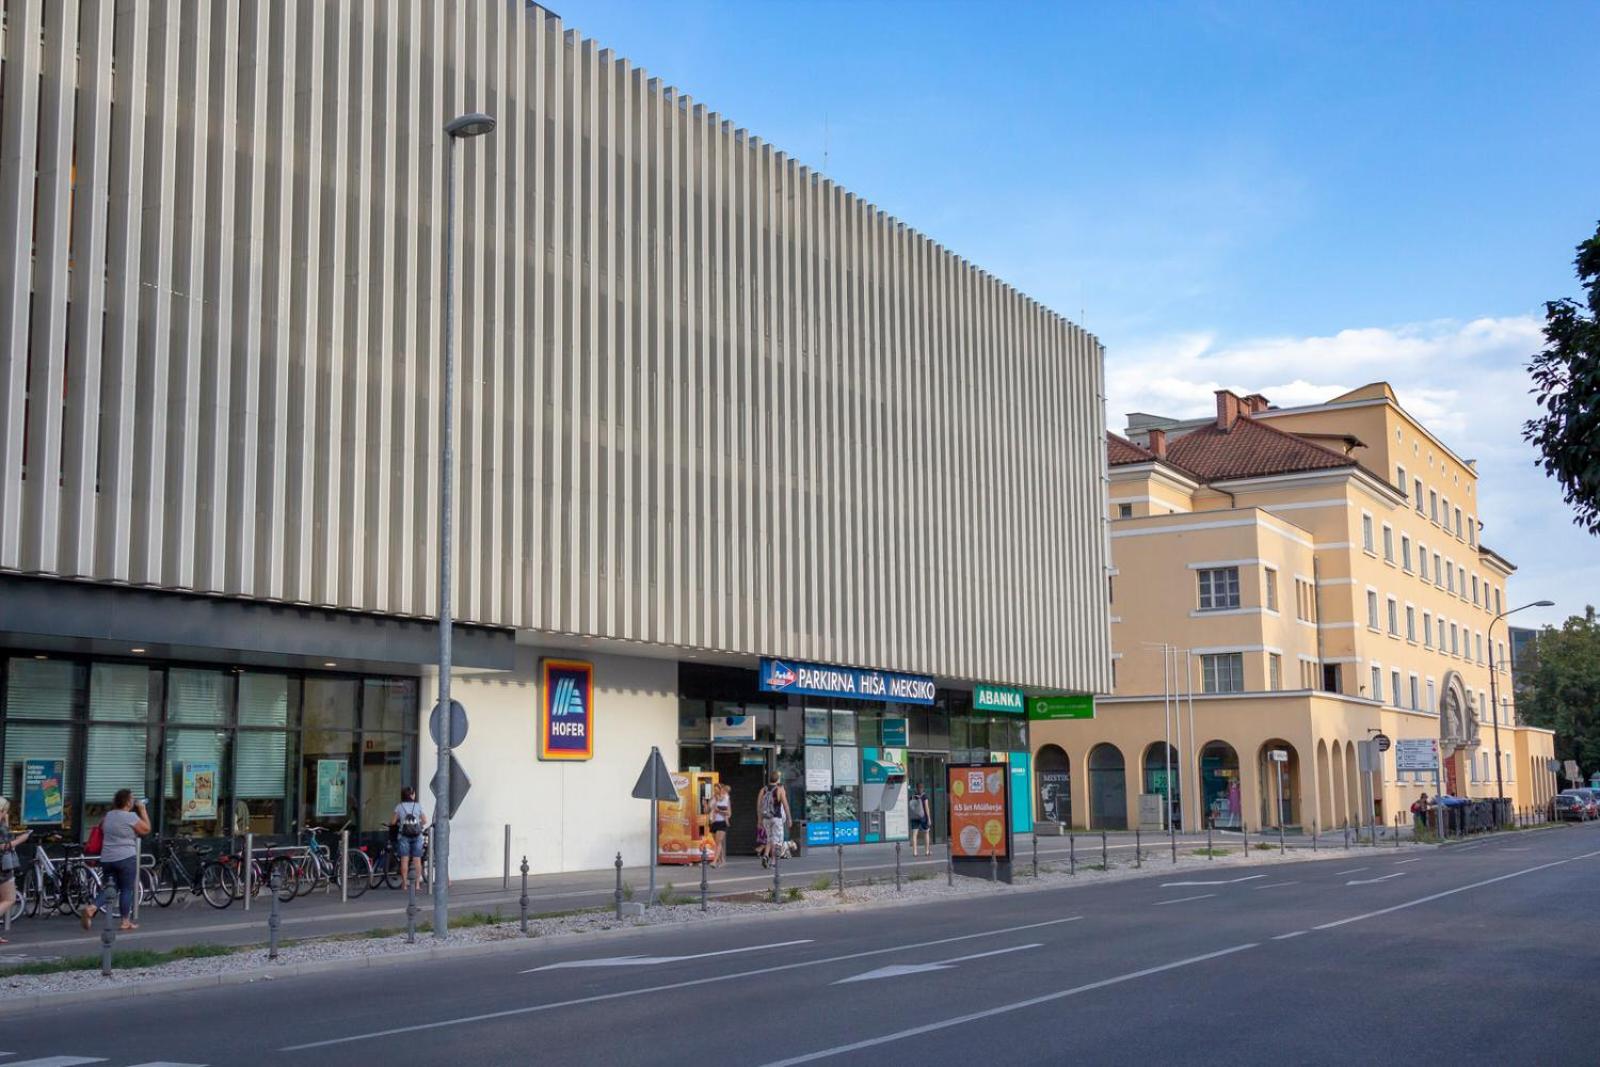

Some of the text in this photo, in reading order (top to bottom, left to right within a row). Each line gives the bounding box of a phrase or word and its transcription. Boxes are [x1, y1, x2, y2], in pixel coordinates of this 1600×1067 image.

[798, 668, 856, 693] PARKIRNA
[860, 671, 887, 696] HIŠA
[891, 678, 936, 700] MEKSIKO
[978, 689, 1022, 708] ABANKA
[552, 721, 585, 736] HOFER
